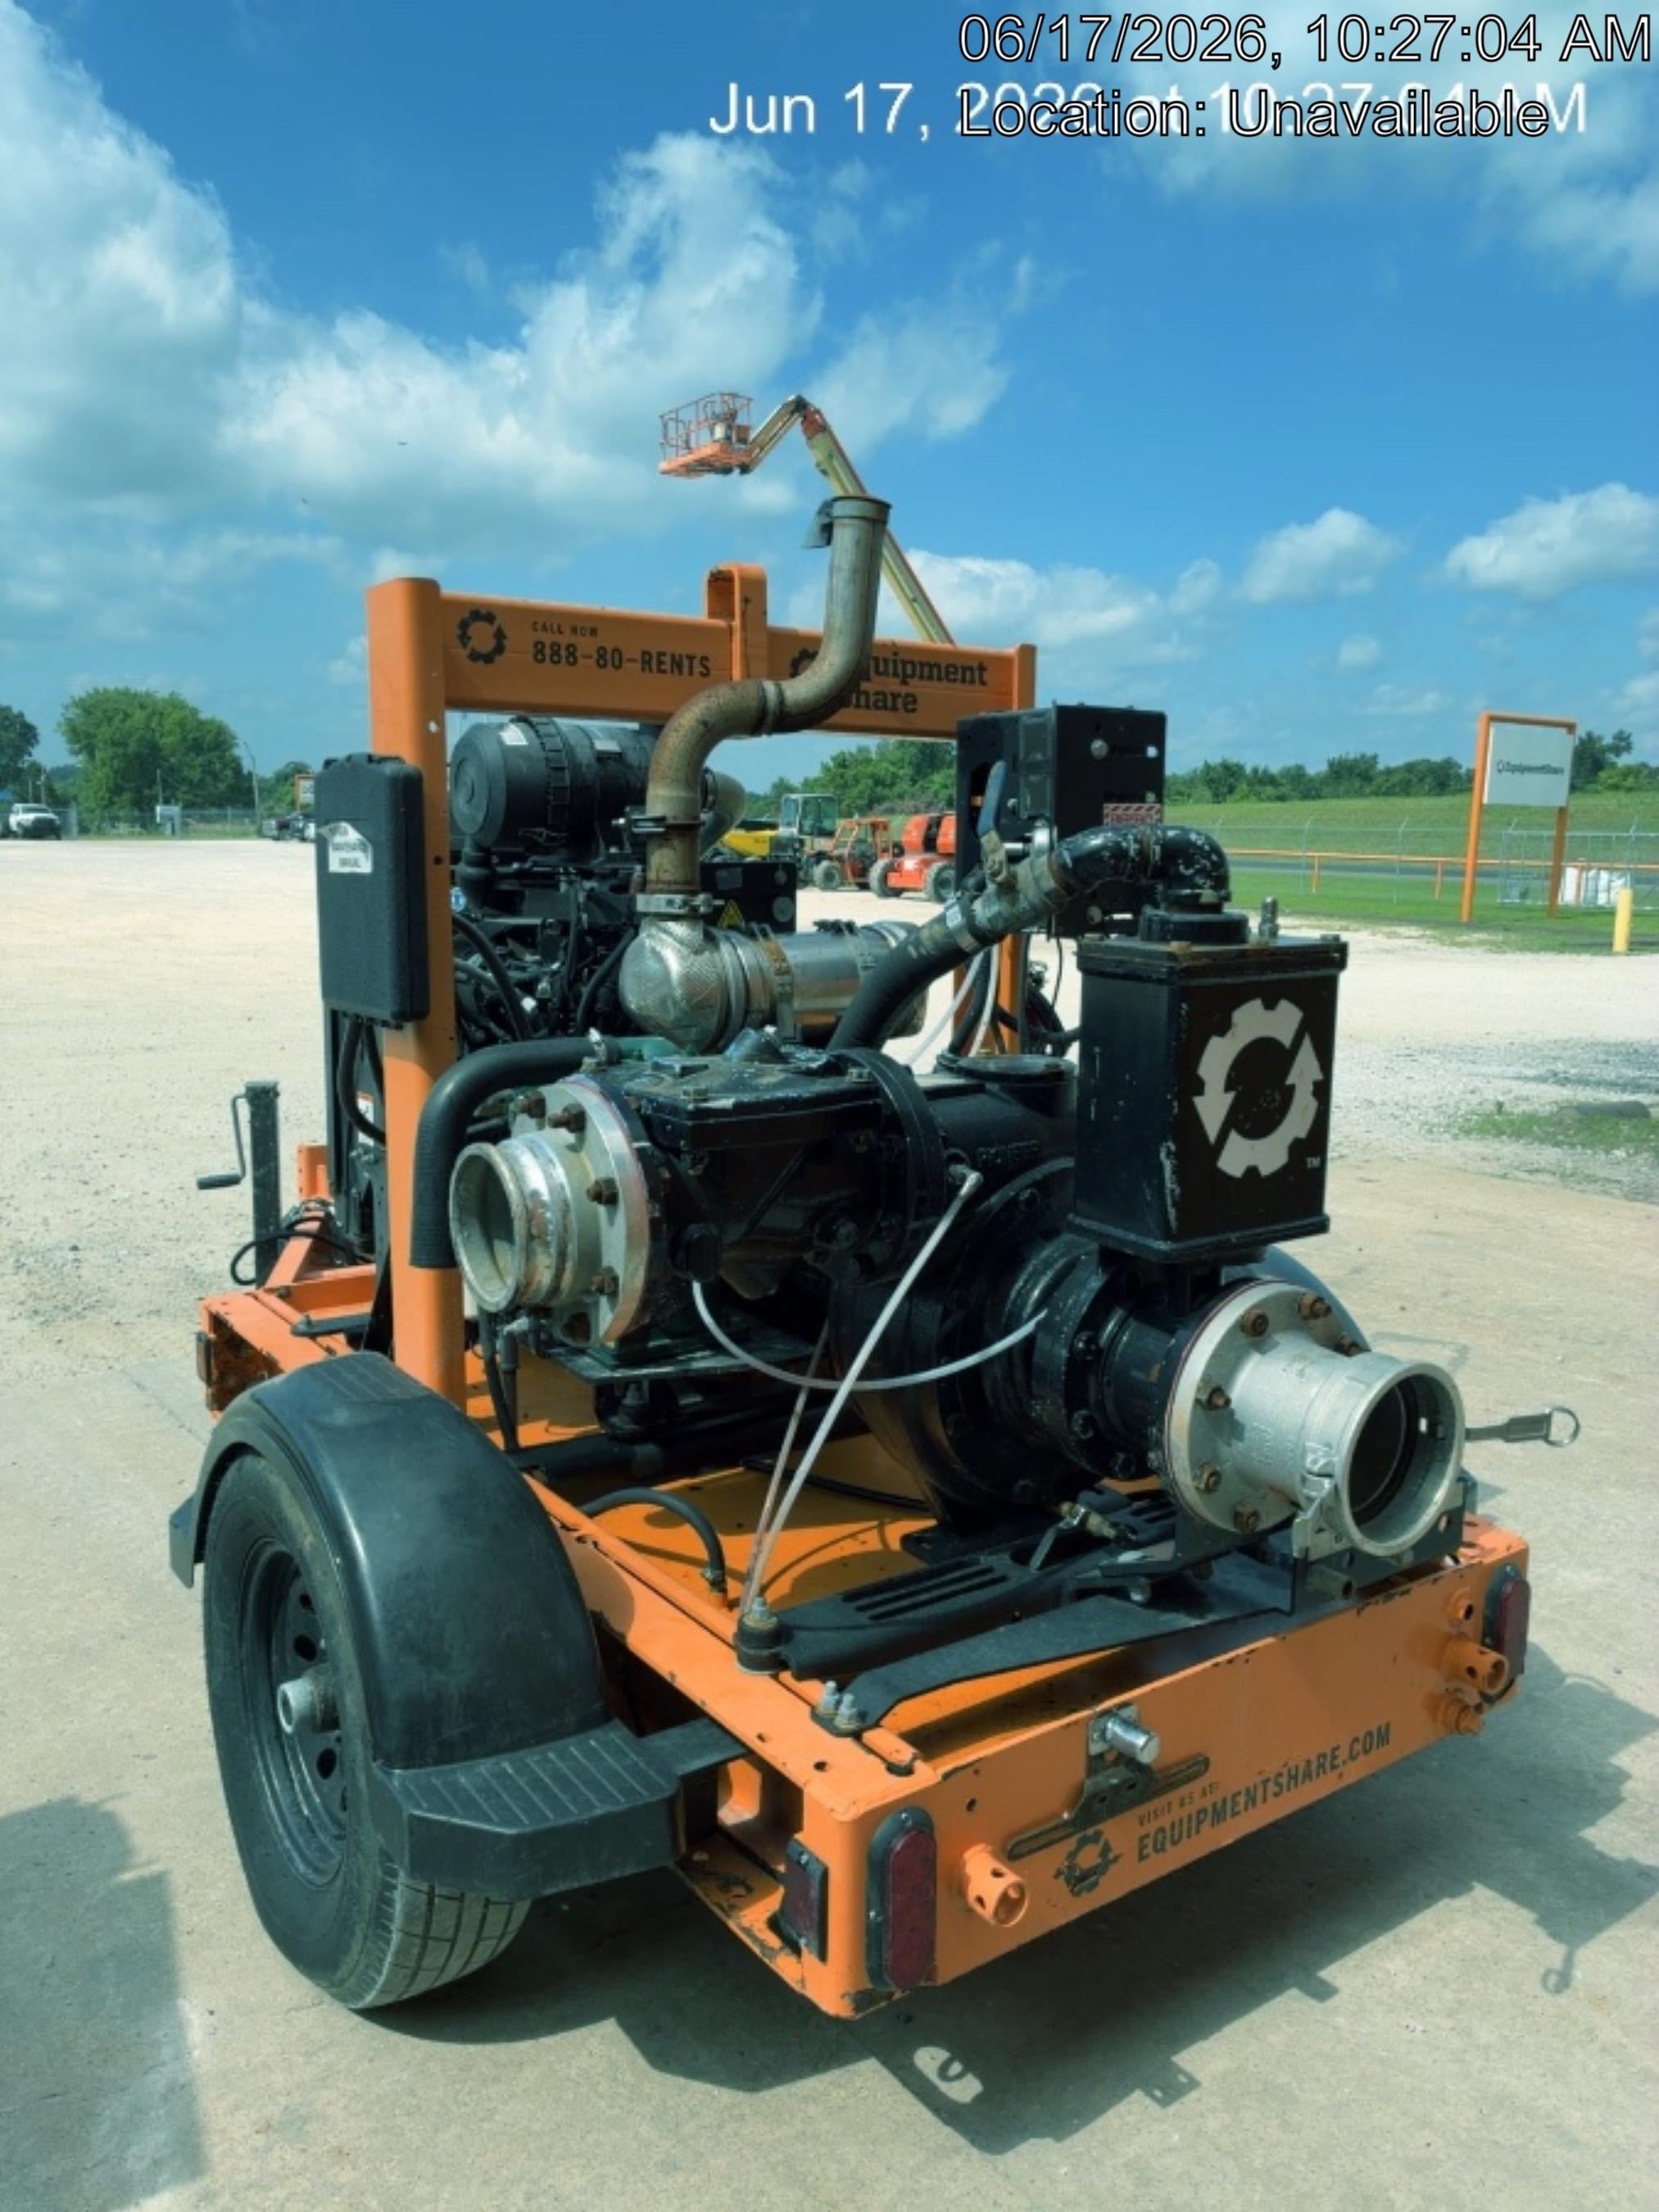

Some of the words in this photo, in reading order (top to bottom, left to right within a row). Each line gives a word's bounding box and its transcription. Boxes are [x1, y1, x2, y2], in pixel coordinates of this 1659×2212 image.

[533, 622, 564, 635] CALL
[570, 626, 598, 637] NOW
[533, 641, 711, 678] 888-80-RENTS
[849, 680, 918, 713] hare
[1137, 1720, 1391, 1863] EQUIPMENTSHARE.COM
[1138, 1802, 1172, 1827] VISIT
